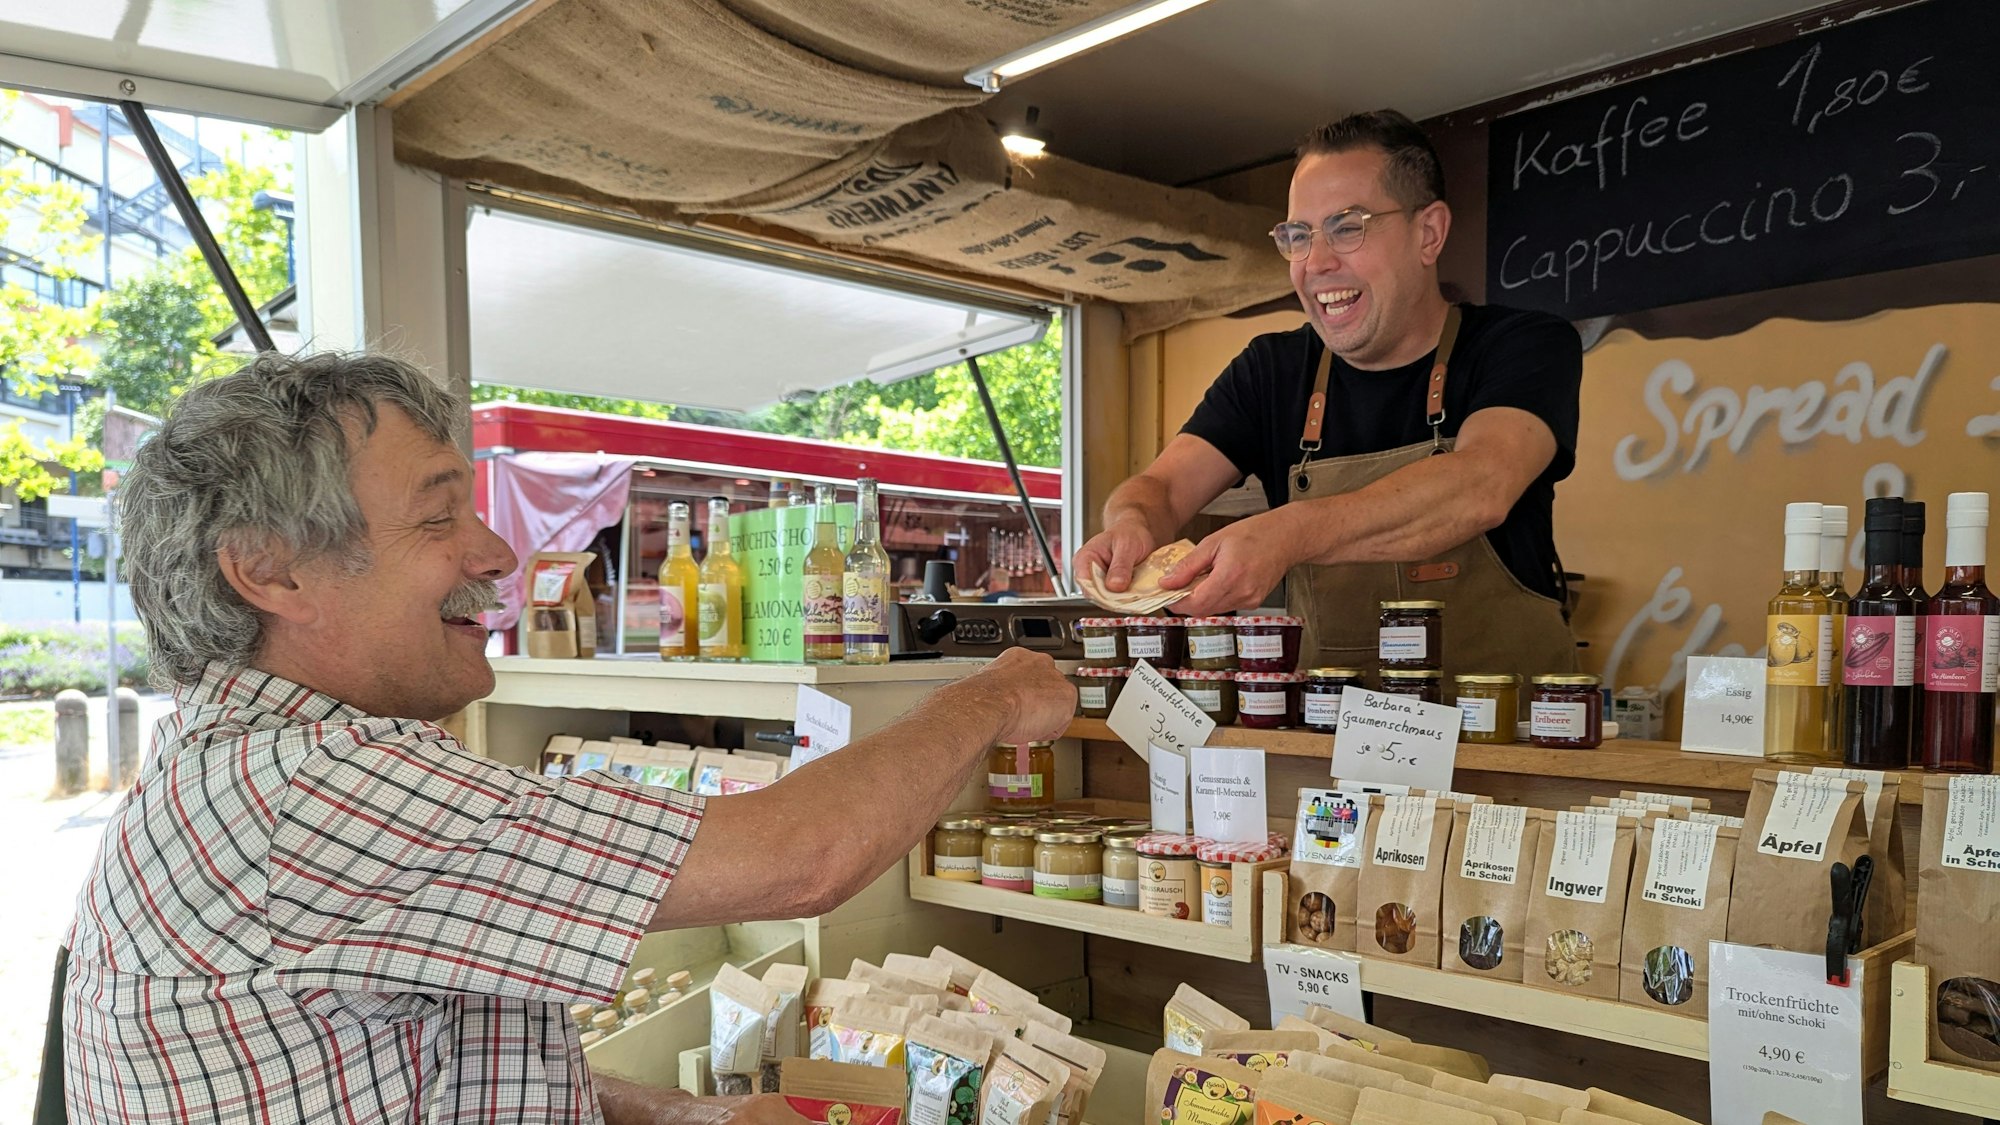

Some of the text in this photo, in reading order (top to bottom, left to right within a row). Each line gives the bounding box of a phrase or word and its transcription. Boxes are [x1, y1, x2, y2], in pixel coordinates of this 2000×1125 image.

[1512, 97, 1710, 190] Kaffee
[1500, 172, 1856, 303] Cappuccino
[1613, 342, 1948, 482] Spread
[759, 557, 793, 576] 2,50 €
[758, 628, 780, 648] 3,20
[783, 628, 792, 646] €
[1134, 665, 1203, 728] Fruchtaufstriche
[1726, 688, 1752, 700] Essig
[1342, 710, 1444, 741] Gaumenschmaus
[1535, 716, 1572, 724] Erdbeere
[1721, 713, 1754, 724] 14,90€
[1356, 742, 1372, 755] je
[1198, 774, 1251, 785] Genussrausch &
[1196, 786, 1257, 798] Karamell-Meersalz
[1213, 811, 1232, 821] 7,90€
[1761, 832, 1823, 855] Äpfel
[1376, 846, 1425, 866] Aprikosen
[1946, 855, 1960, 865] in
[1464, 860, 1514, 872] Aprikosen
[1466, 868, 1512, 882] in Schoki
[1548, 876, 1604, 897] Ingwer
[1654, 881, 1696, 895] Ingwer
[1644, 890, 1701, 907] in Schoki
[1210, 917, 1230, 926] Creme
[1276, 964, 1290, 974] TV
[1300, 967, 1349, 984] SNACKS
[1298, 980, 1330, 996] 5,90 €
[1726, 986, 1840, 1016] Trockenfrüchte
[1738, 1008, 1826, 1029] mit/ohne Schoki
[1759, 1045, 1806, 1064] 4,90 €
